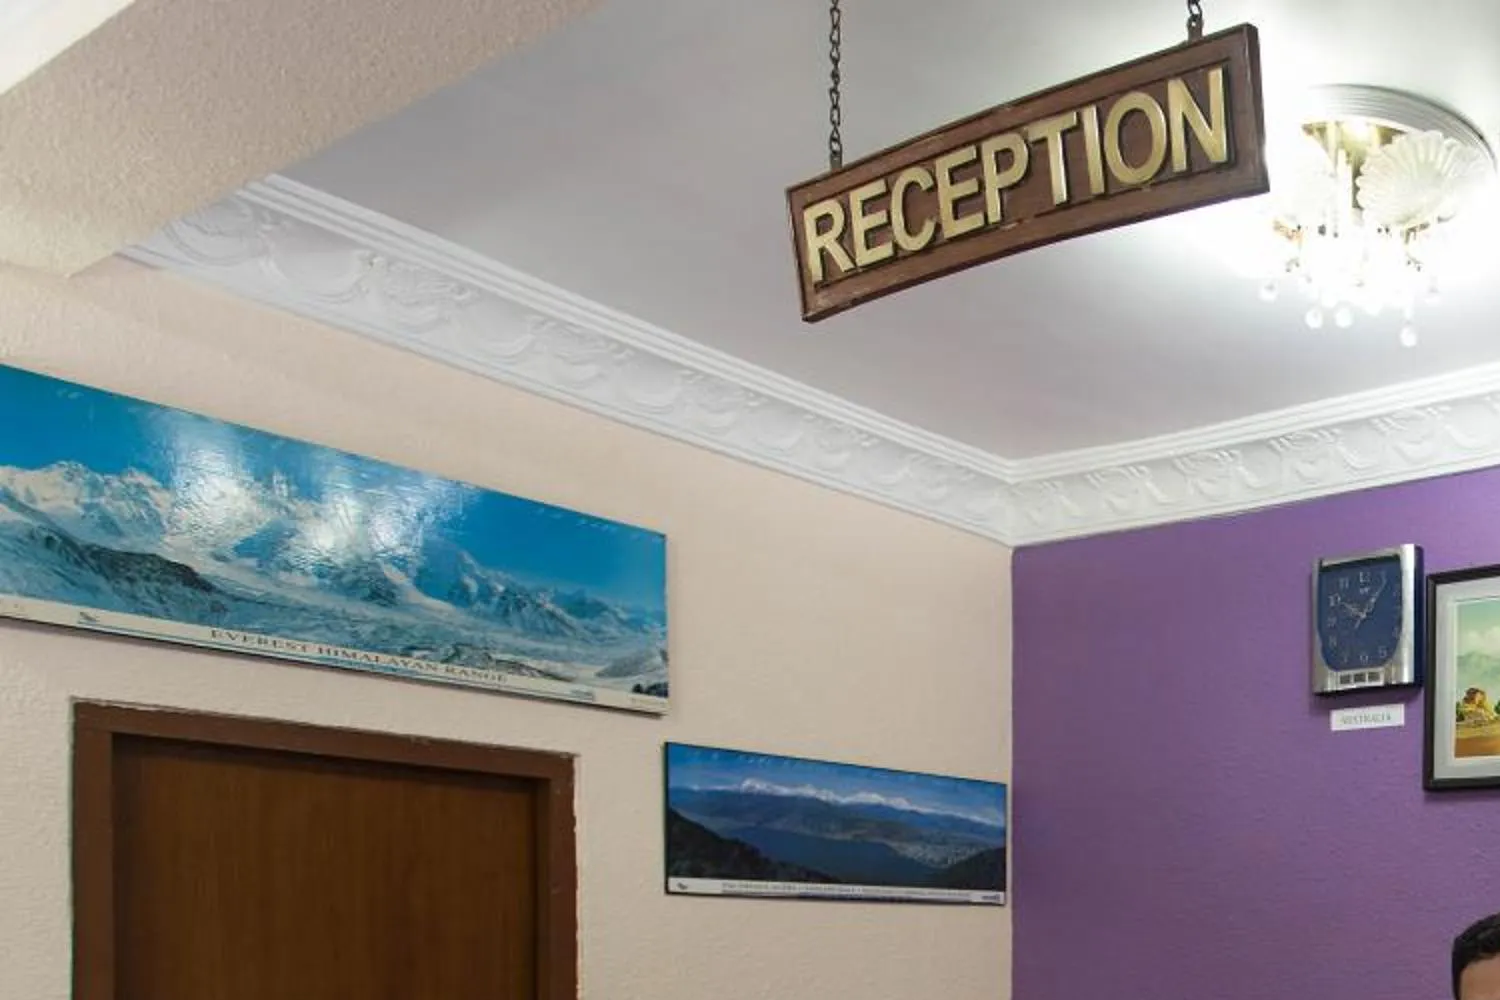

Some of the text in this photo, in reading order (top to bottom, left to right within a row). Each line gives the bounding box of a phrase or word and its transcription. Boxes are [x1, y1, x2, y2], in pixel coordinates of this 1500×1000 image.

[803, 66, 1229, 283] RECEPTION
[210, 629, 509, 685] EVEREST HIMALAYAN RANGE
